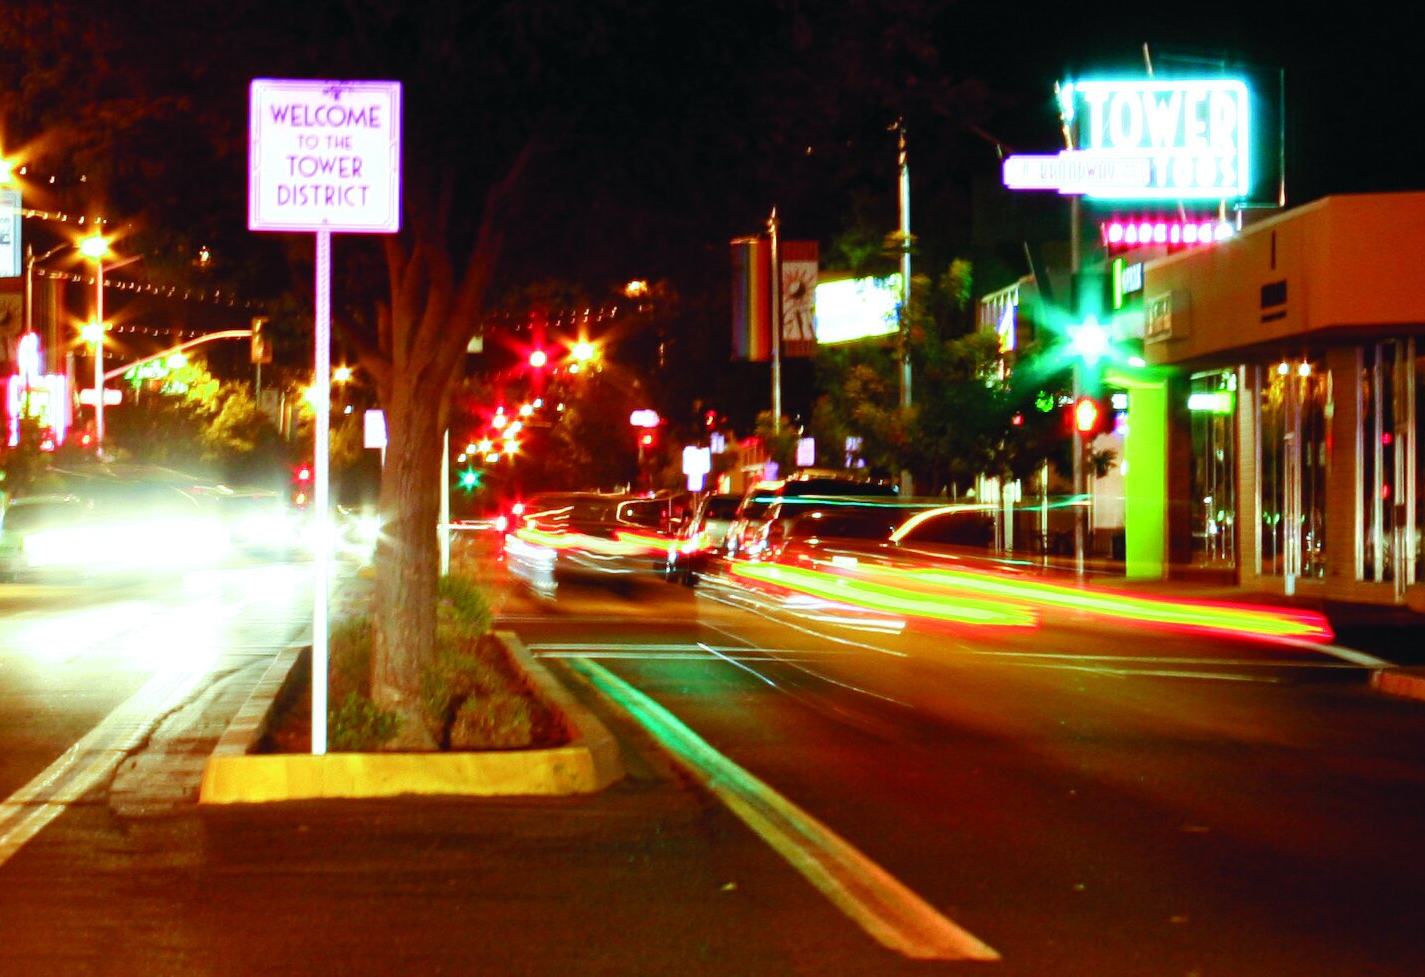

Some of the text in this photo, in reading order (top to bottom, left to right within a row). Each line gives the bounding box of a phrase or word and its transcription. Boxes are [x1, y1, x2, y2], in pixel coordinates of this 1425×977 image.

[270, 104, 382, 128] WELCOME
[1084, 88, 1237, 153] TOWER
[297, 134, 353, 151] TO THE
[286, 154, 364, 178] TOWER
[277, 184, 370, 207] DISTRICT
